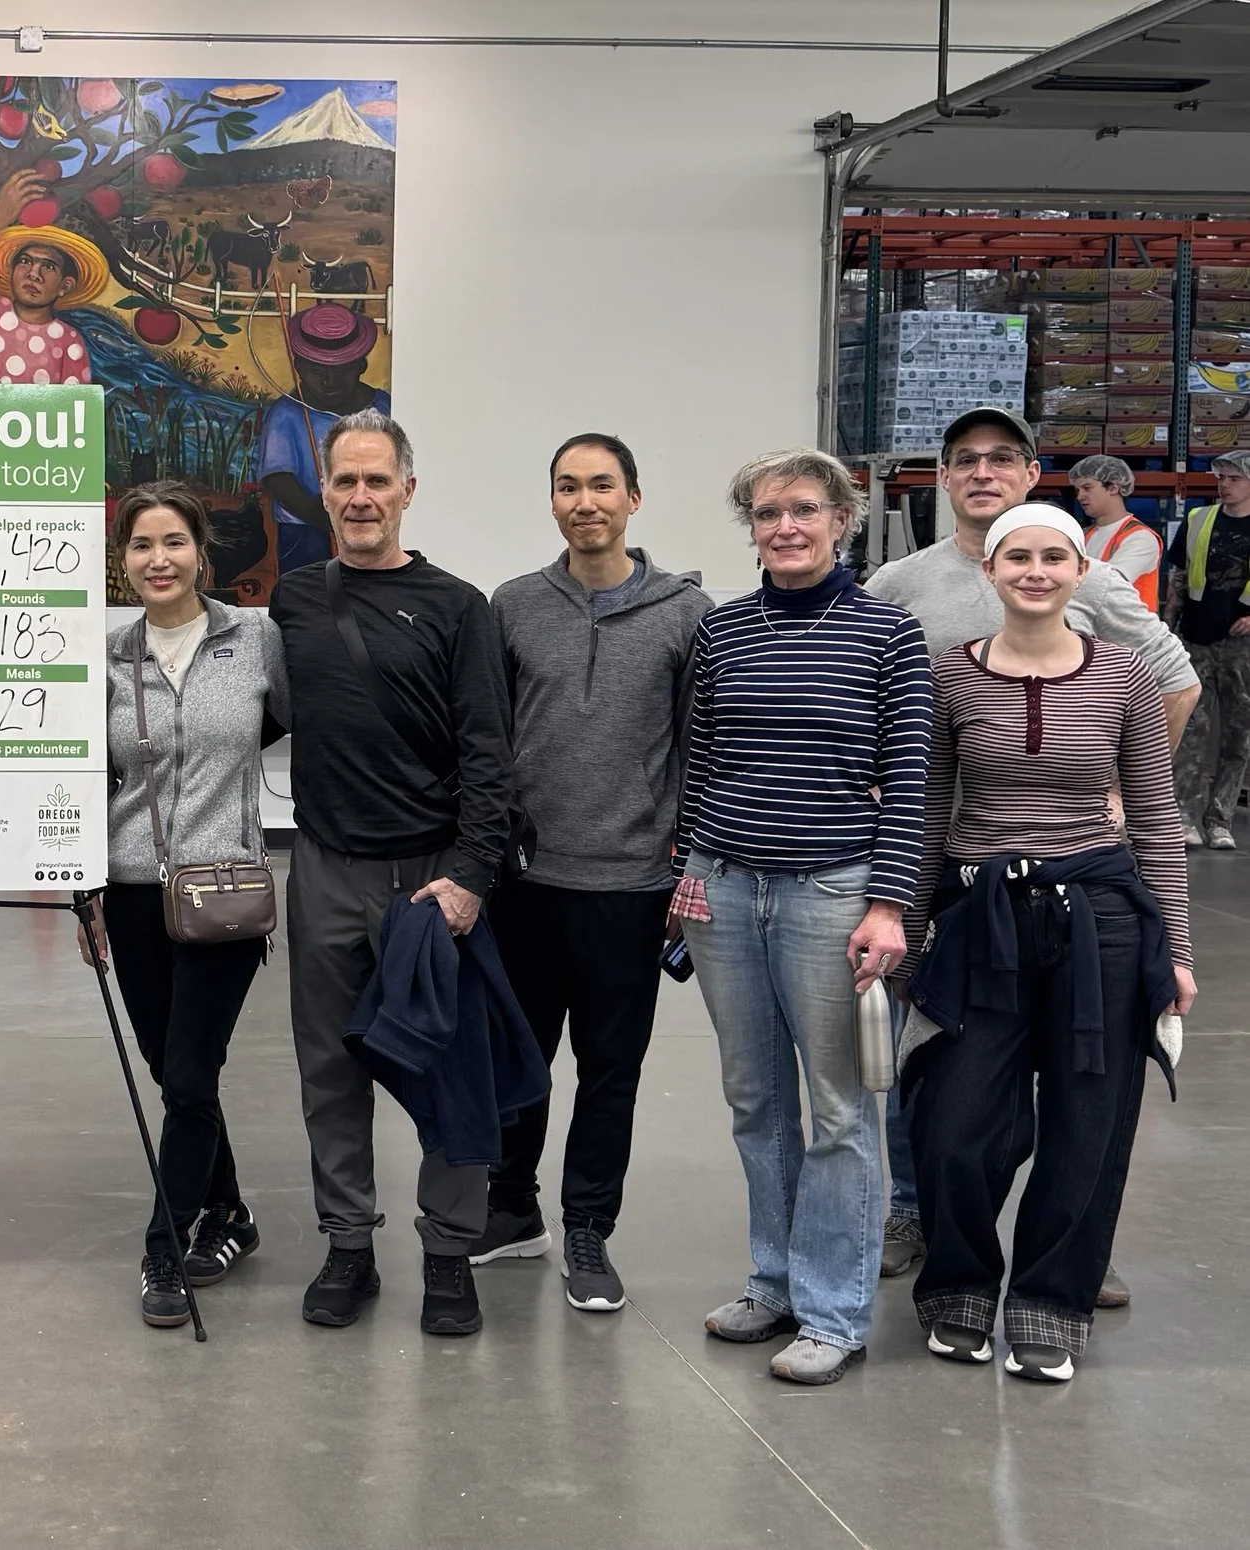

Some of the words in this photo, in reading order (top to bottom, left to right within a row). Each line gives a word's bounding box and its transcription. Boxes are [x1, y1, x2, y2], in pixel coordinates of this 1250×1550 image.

[2, 459, 85, 493] today
[36, 520, 85, 533] repack:
[2, 593, 45, 604] Pounds
[6, 668, 41, 679] Meals
[5, 746, 24, 756] per
[27, 743, 81, 754] volunteer
[39, 809, 80, 819] OREGON
[39, 826, 58, 837] FOOD
[61, 826, 80, 835] BANK
